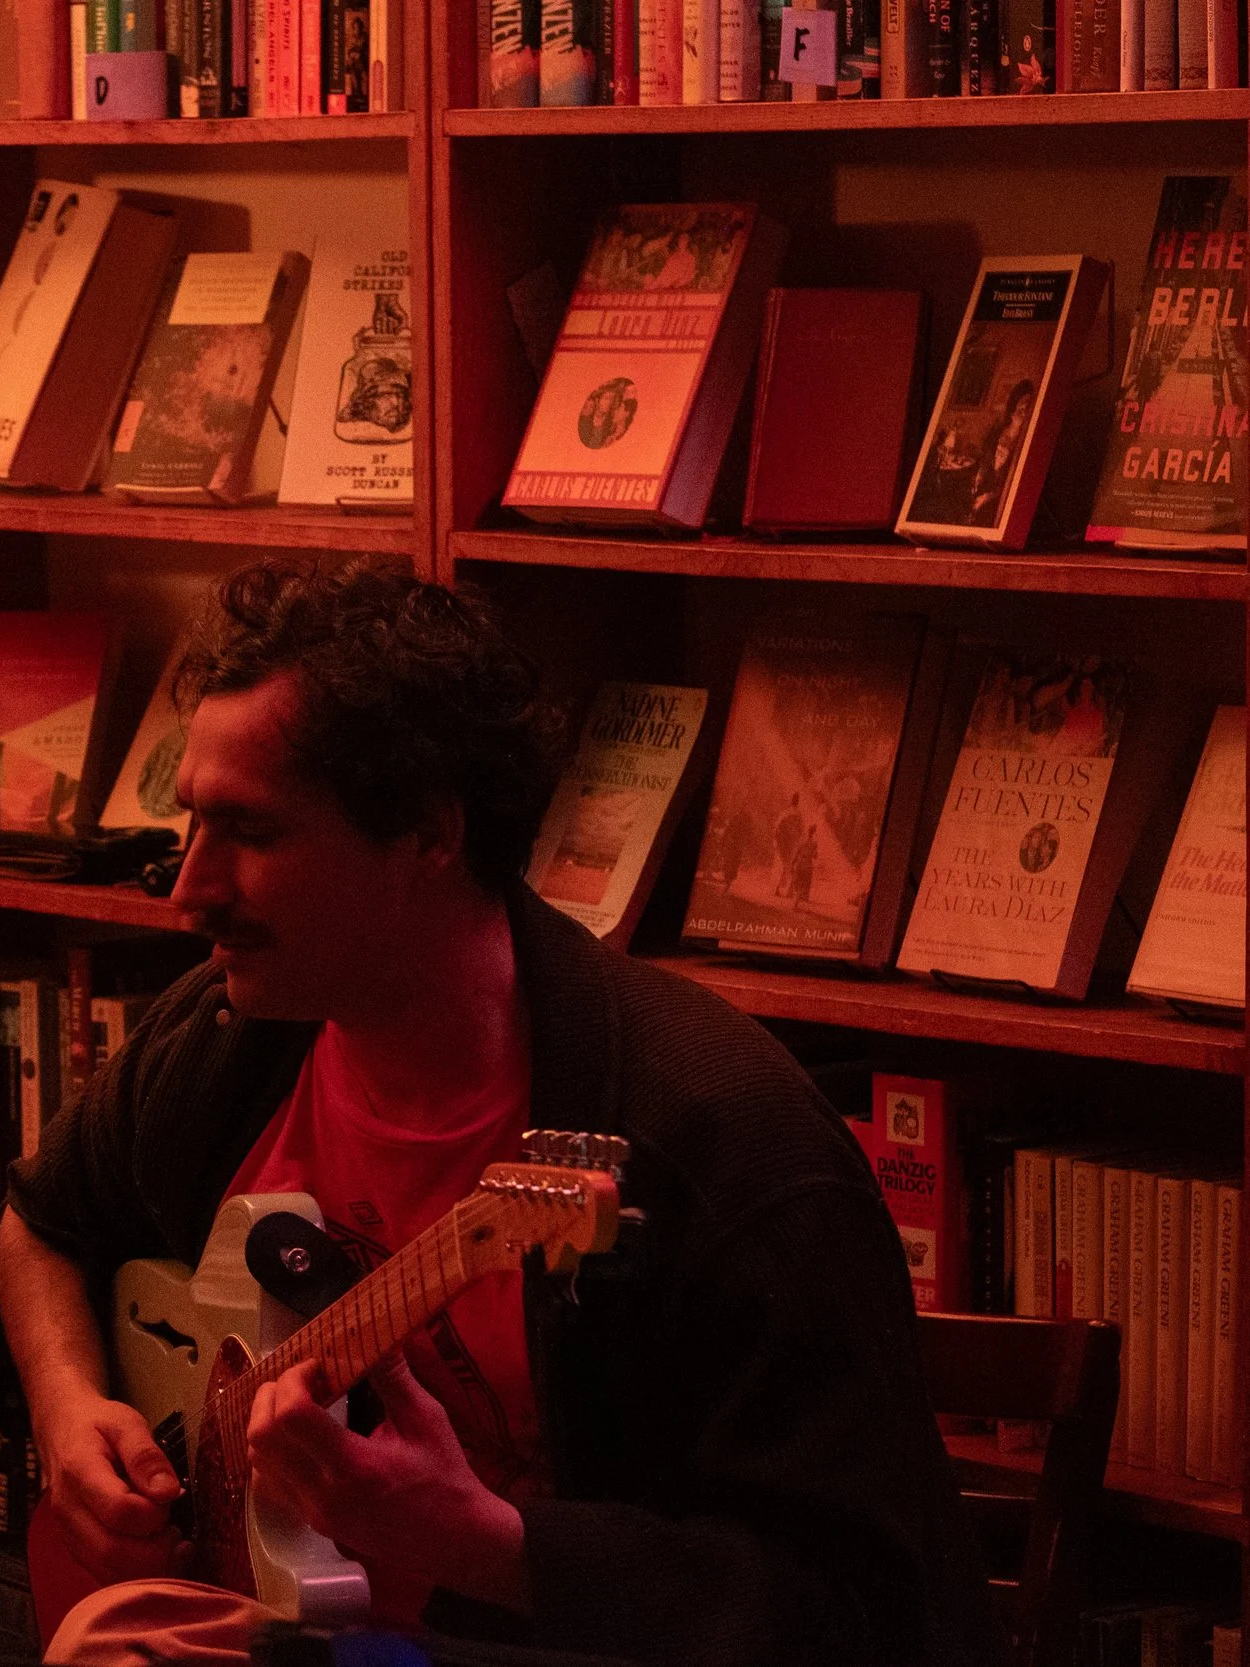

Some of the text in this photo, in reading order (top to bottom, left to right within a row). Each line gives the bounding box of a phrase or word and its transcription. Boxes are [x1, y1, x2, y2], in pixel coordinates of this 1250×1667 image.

[793, 26, 810, 61] F
[95, 76, 109, 105] D
[380, 250, 409, 263] OLD
[1153, 230, 1249, 270] HERE
[342, 278, 404, 291] STRIKES
[325, 467, 366, 477] SCOTT
[371, 454, 387, 464] BY
[1121, 440, 1233, 484] GARCÍA
[352, 480, 399, 489] DUNCAN
[592, 712, 686, 750] GORDIMER
[801, 712, 880, 728] AND DAY
[971, 755, 1094, 790] CARLOS
[953, 786, 1094, 824] FUENTES
[952, 846, 997, 867] THE
[1178, 846, 1214, 869] The
[931, 867, 1067, 899] YEARS WITH
[922, 886, 998, 918] LAURA
[686, 918, 798, 938] ABDELRAHMAN
[877, 1155, 938, 1181] DANZIG
[896, 1146, 915, 1160] THE
[877, 1172, 937, 1197] TRILOGY
[1059, 1170, 1069, 1252] GRAHAM GREENE
[1074, 1173, 1088, 1314] GRAHAM GREENE
[1109, 1180, 1121, 1322] GRAHAM GREENE
[1132, 1179, 1145, 1321] GRAHAM GREENE
[1220, 1197, 1234, 1274] GRAHAM
[1159, 1190, 1172, 1332] GRAHAM GREENE
[1190, 1190, 1204, 1333] GRAHAM GREENE
[1219, 1276, 1233, 1344] GREENE
